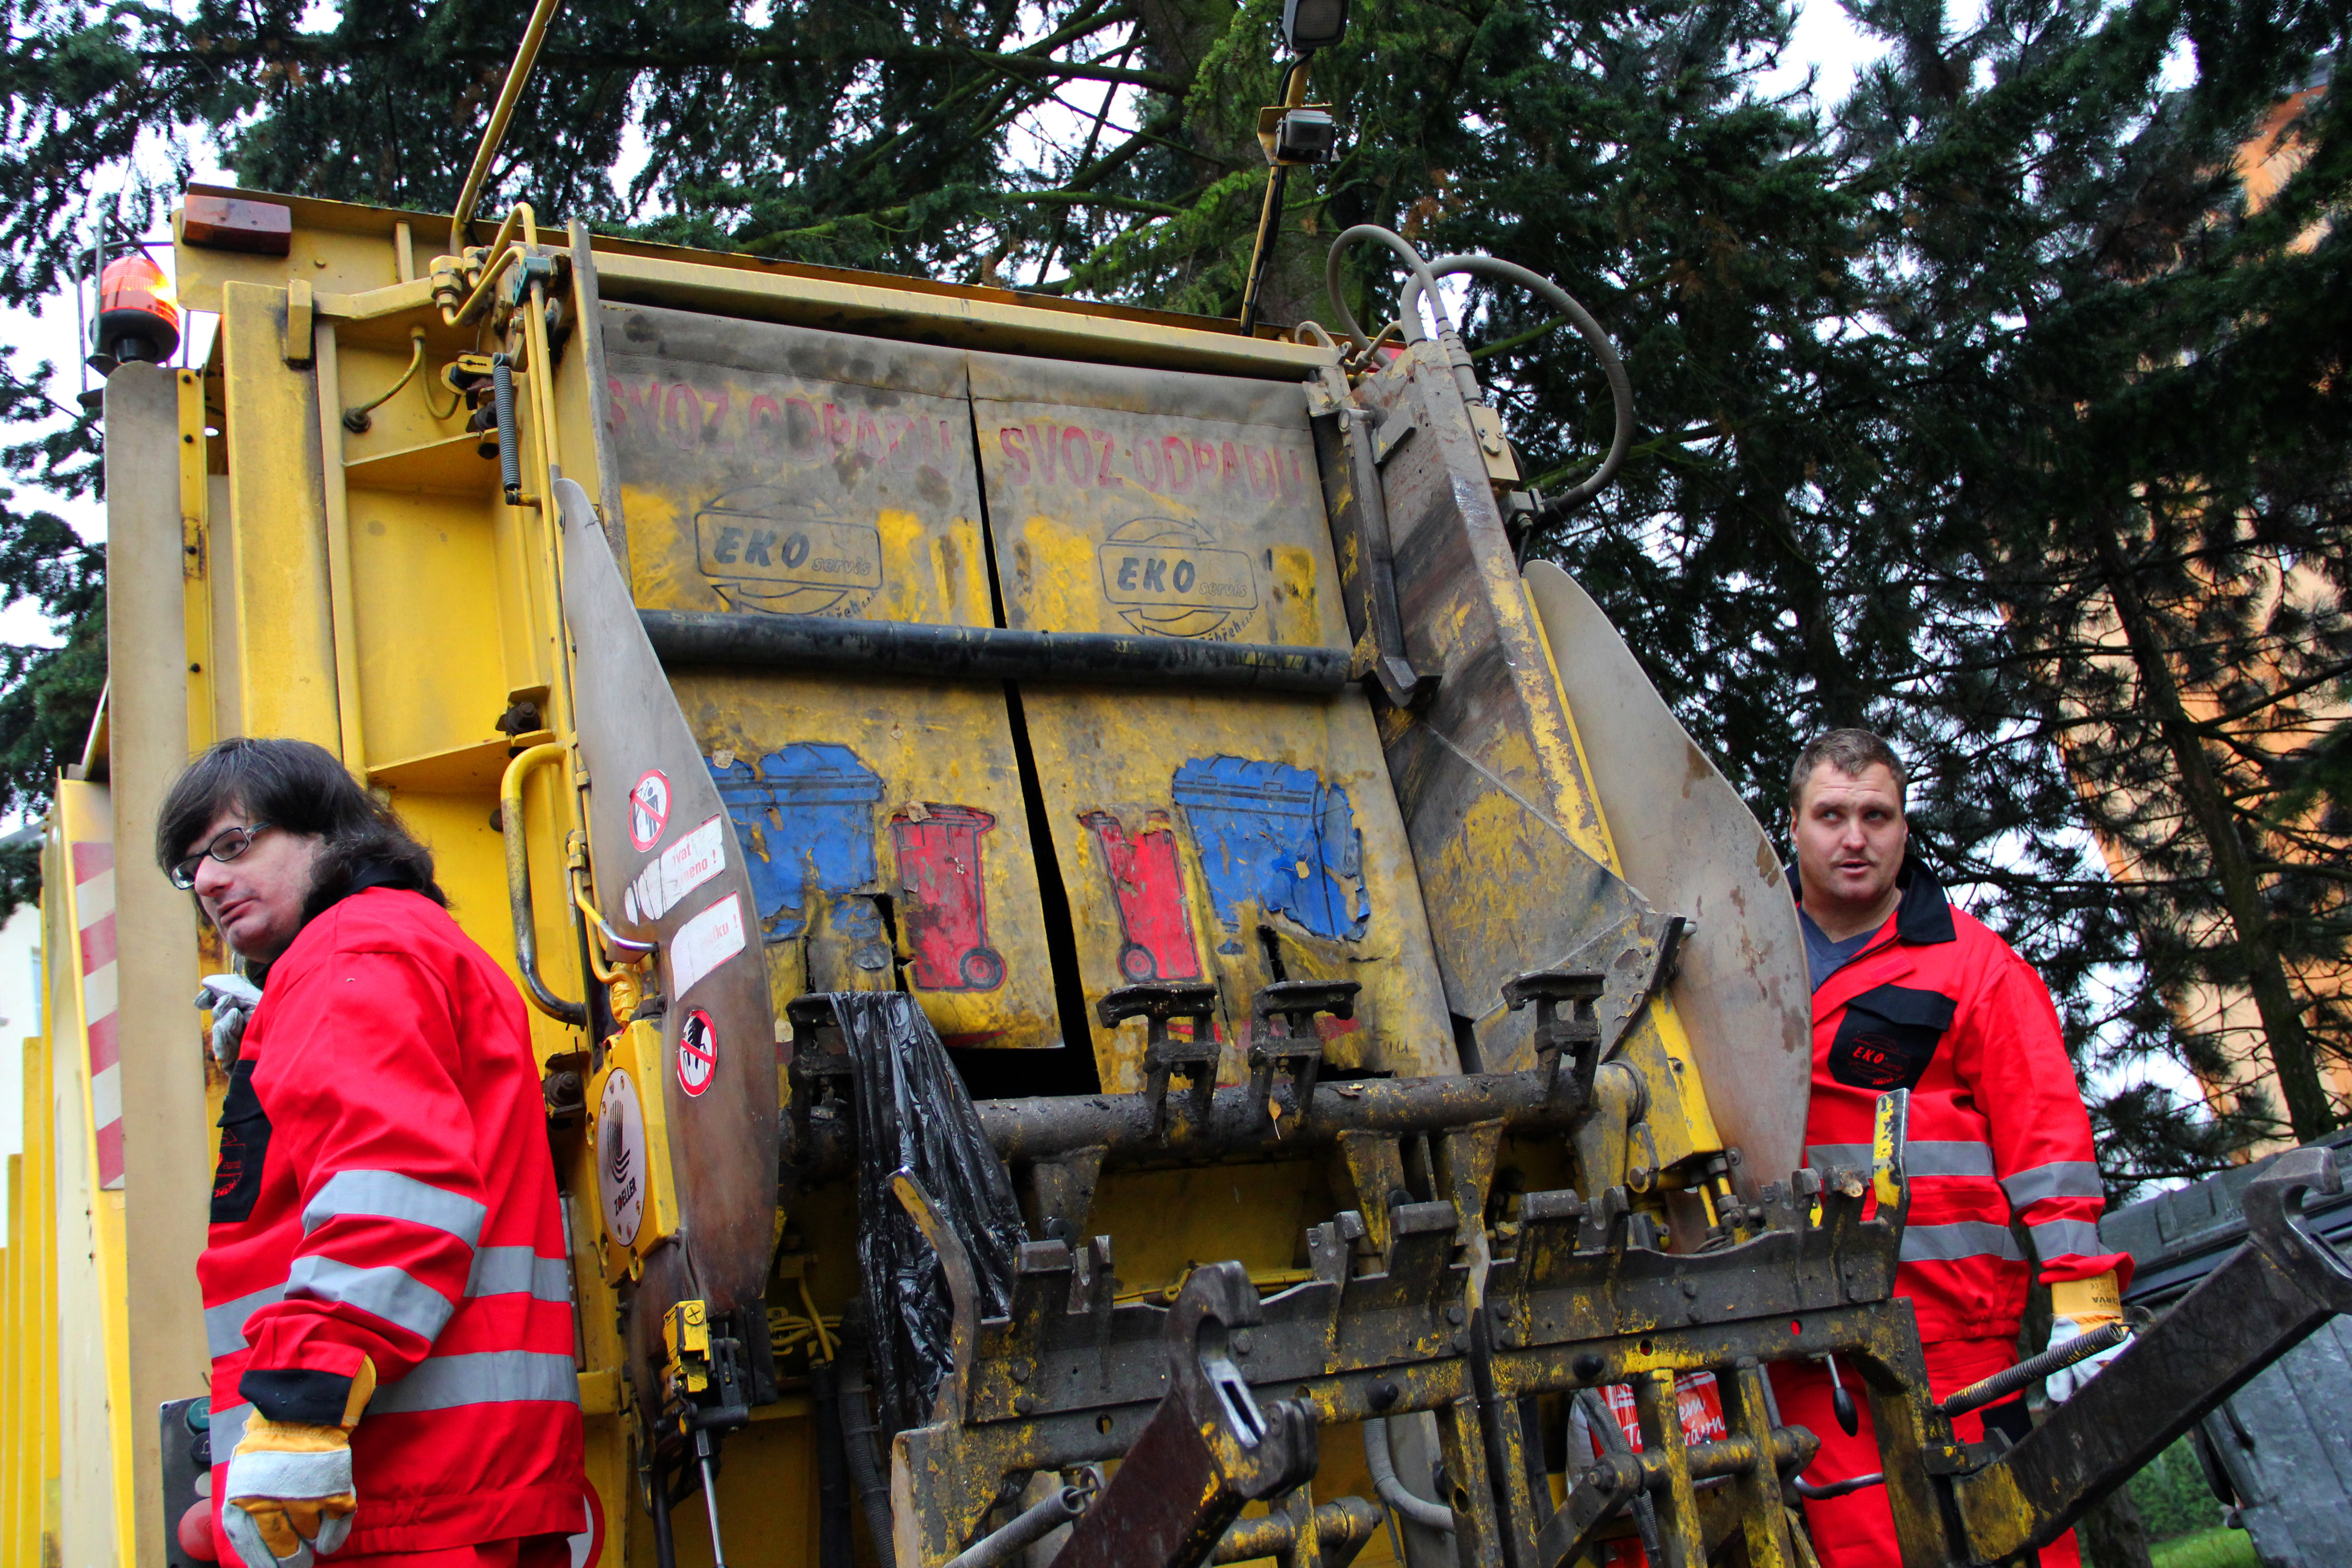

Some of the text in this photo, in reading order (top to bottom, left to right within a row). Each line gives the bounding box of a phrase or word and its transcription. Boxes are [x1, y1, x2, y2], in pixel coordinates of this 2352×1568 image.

[607, 375, 953, 473] SVOZ ODPADU
[1000, 425, 1305, 506] SVOZ ODPADU
[713, 526, 810, 569] EKO
[811, 556, 872, 577] servis
[1117, 557, 1196, 593] EKO
[1198, 580, 1247, 598] servis
[1852, 1046, 1886, 1064] EKO
[614, 1176, 637, 1217] ZOELLER
